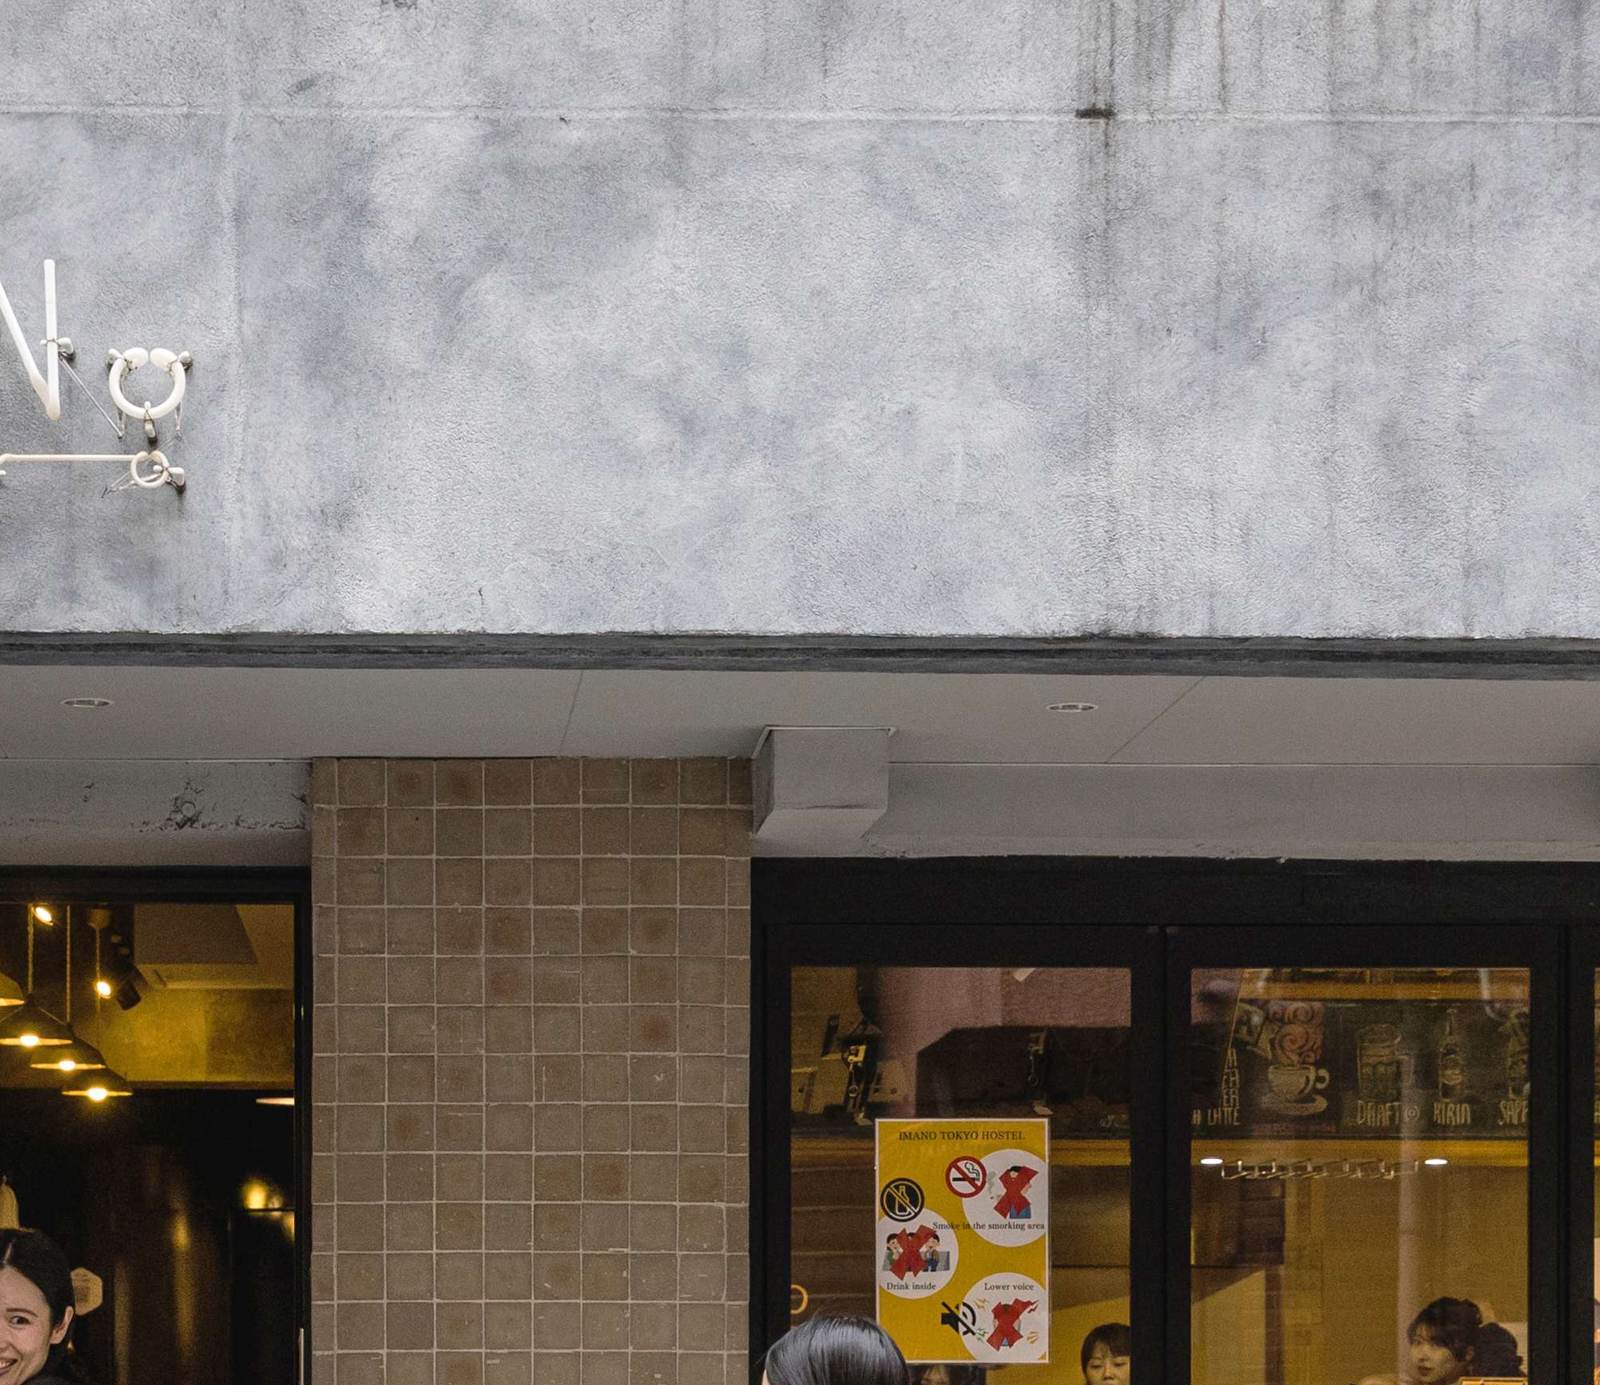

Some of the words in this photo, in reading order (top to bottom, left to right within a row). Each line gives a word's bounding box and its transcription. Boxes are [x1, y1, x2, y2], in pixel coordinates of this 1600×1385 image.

[1357, 1100, 1401, 1127] DRAFT
[1434, 1103, 1471, 1126] KIRIN
[898, 1131, 937, 1140] IMANO
[940, 1131, 978, 1140] TOKYO
[981, 1131, 1025, 1140] HOSTEL
[932, 1222, 960, 1230] Smoke
[962, 1222, 971, 1230] in
[973, 1222, 986, 1230] the
[987, 1222, 1025, 1232] smorking
[886, 1282, 909, 1290] Drink
[912, 1282, 936, 1290] inside
[984, 1282, 1010, 1291] Lower
[1012, 1282, 1034, 1291] voice
